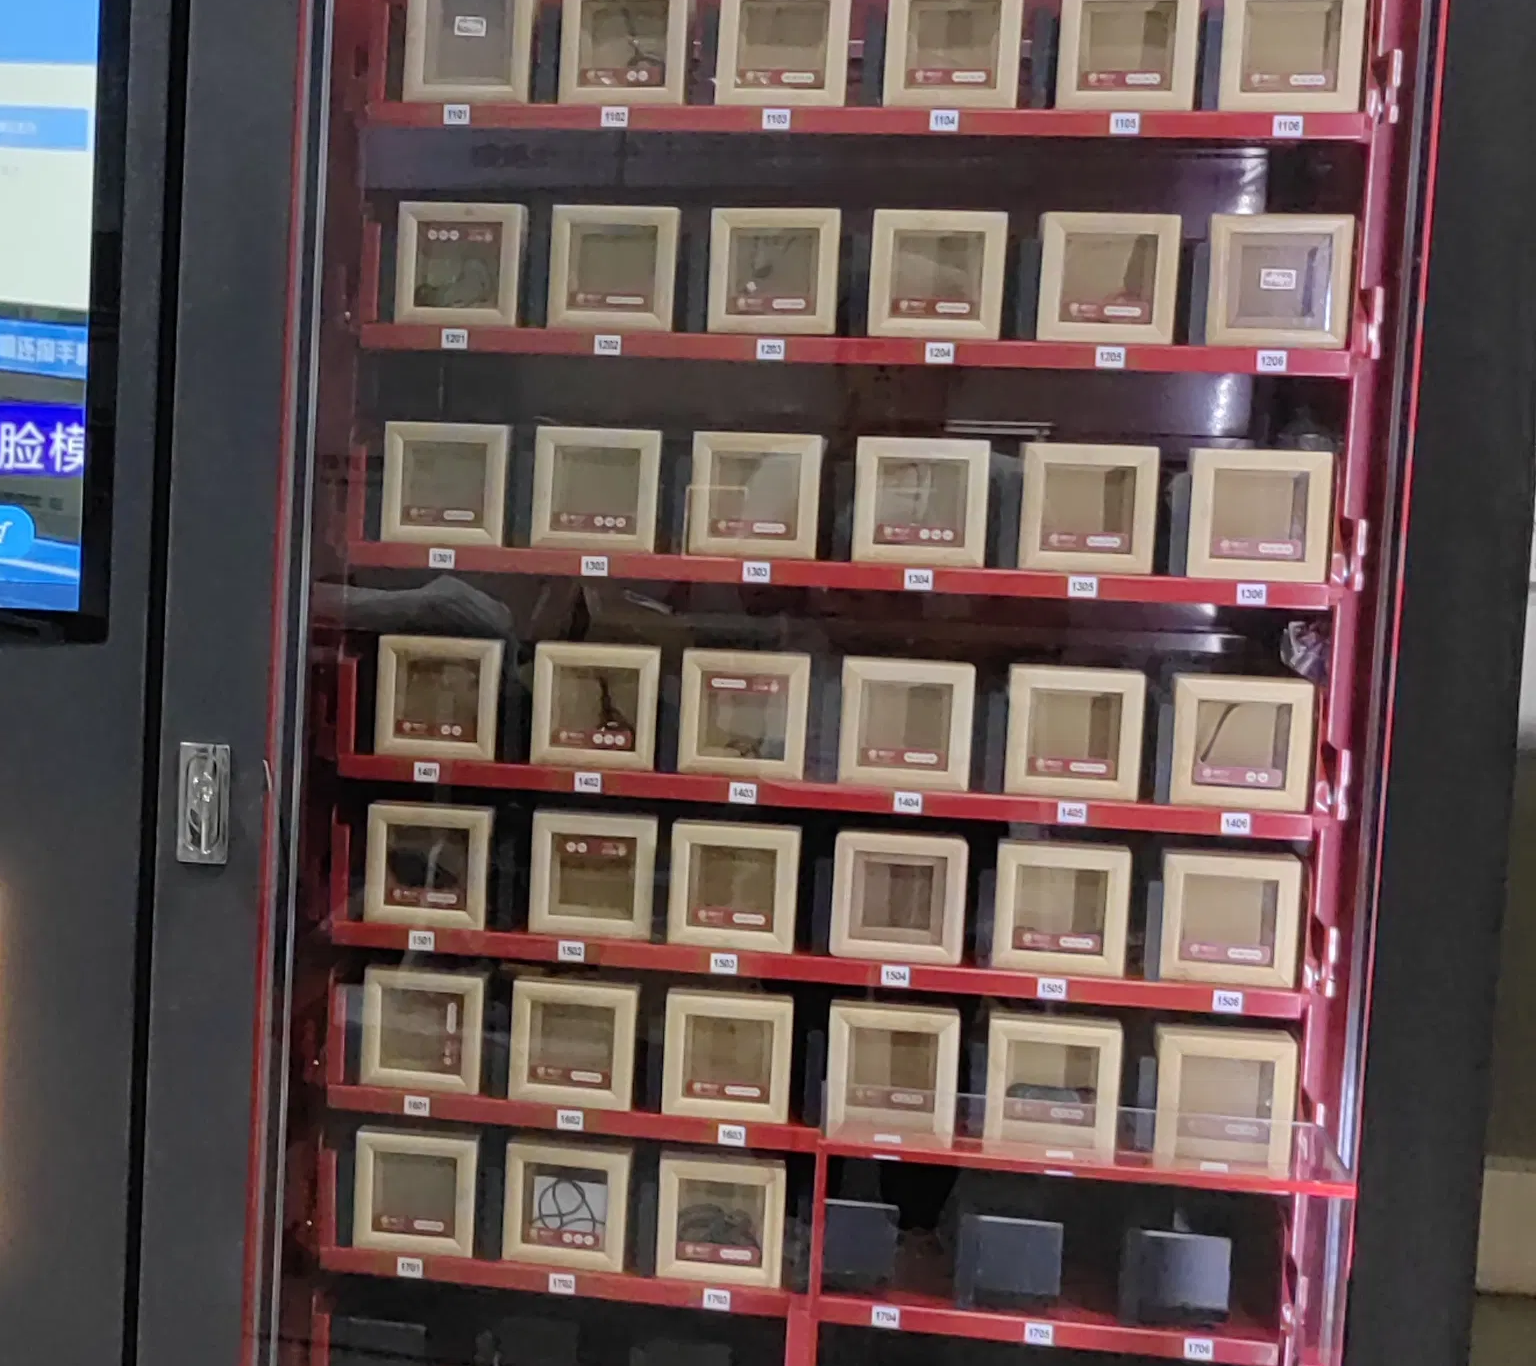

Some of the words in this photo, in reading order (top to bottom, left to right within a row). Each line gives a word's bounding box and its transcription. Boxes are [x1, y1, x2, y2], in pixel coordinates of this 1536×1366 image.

[605, 111, 626, 122] 1102
[766, 114, 788, 125] 1103
[934, 115, 956, 126] 1104
[1115, 118, 1137, 129] 1105
[1278, 121, 1300, 131] 1106
[445, 334, 465, 344] 1201
[598, 340, 619, 351] 1202
[761, 344, 782, 355] 1203
[929, 347, 951, 358] 1204
[1100, 351, 1122, 362] 1205
[1261, 356, 1284, 367] 1206
[585, 561, 605, 571] 1302
[747, 566, 768, 577] 1303
[908, 574, 930, 584] 1304
[1072, 581, 1094, 592] 1305
[1241, 589, 1263, 599] 1306
[734, 788, 754, 798] 1403
[898, 797, 919, 808] 1404
[1062, 807, 1084, 818] 1405
[1225, 818, 1248, 829] 1406
[413, 935, 432, 946] 1501
[562, 946, 582, 957] 1502
[714, 958, 735, 969] 1503
[885, 971, 907, 981] 1504
[1041, 983, 1064, 994] 1505
[1218, 996, 1239, 1007] 1506
[876, 1311, 897, 1322] 1704
[1029, 1328, 1050, 1339] 1705
[1188, 1343, 1210, 1354] 1706
